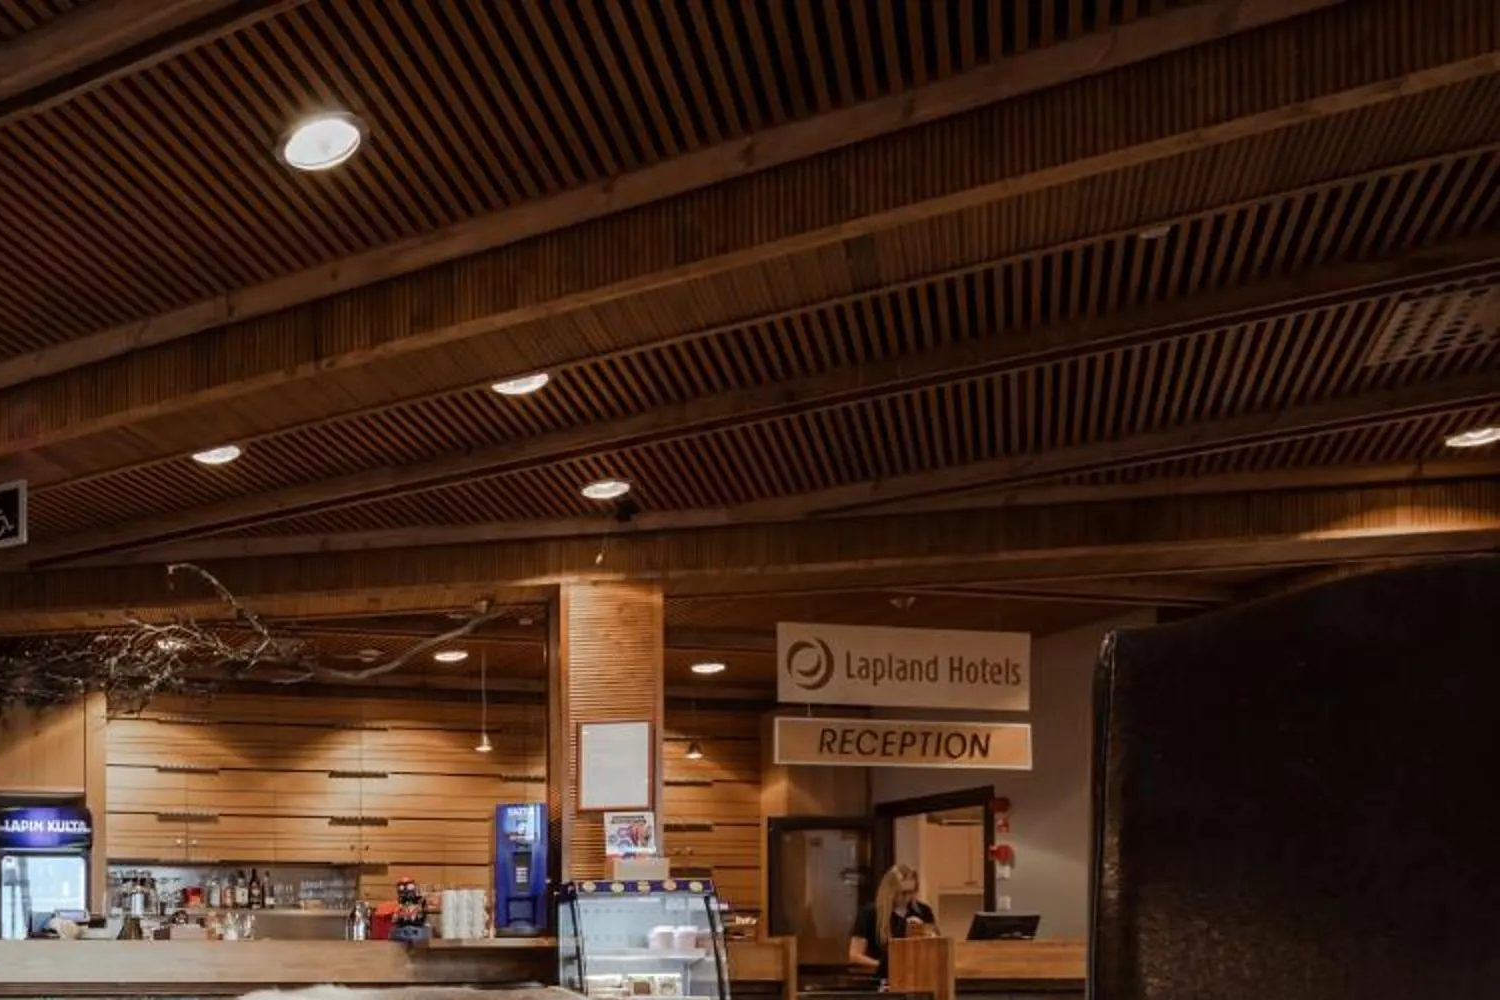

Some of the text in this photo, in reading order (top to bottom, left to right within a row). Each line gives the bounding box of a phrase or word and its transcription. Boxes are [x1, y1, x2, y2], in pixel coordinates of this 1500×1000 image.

[845, 651, 1021, 687] Lapland Hotels
[819, 728, 991, 759] RECEPTION
[0, 819, 89, 833] LAPIN KULTA
